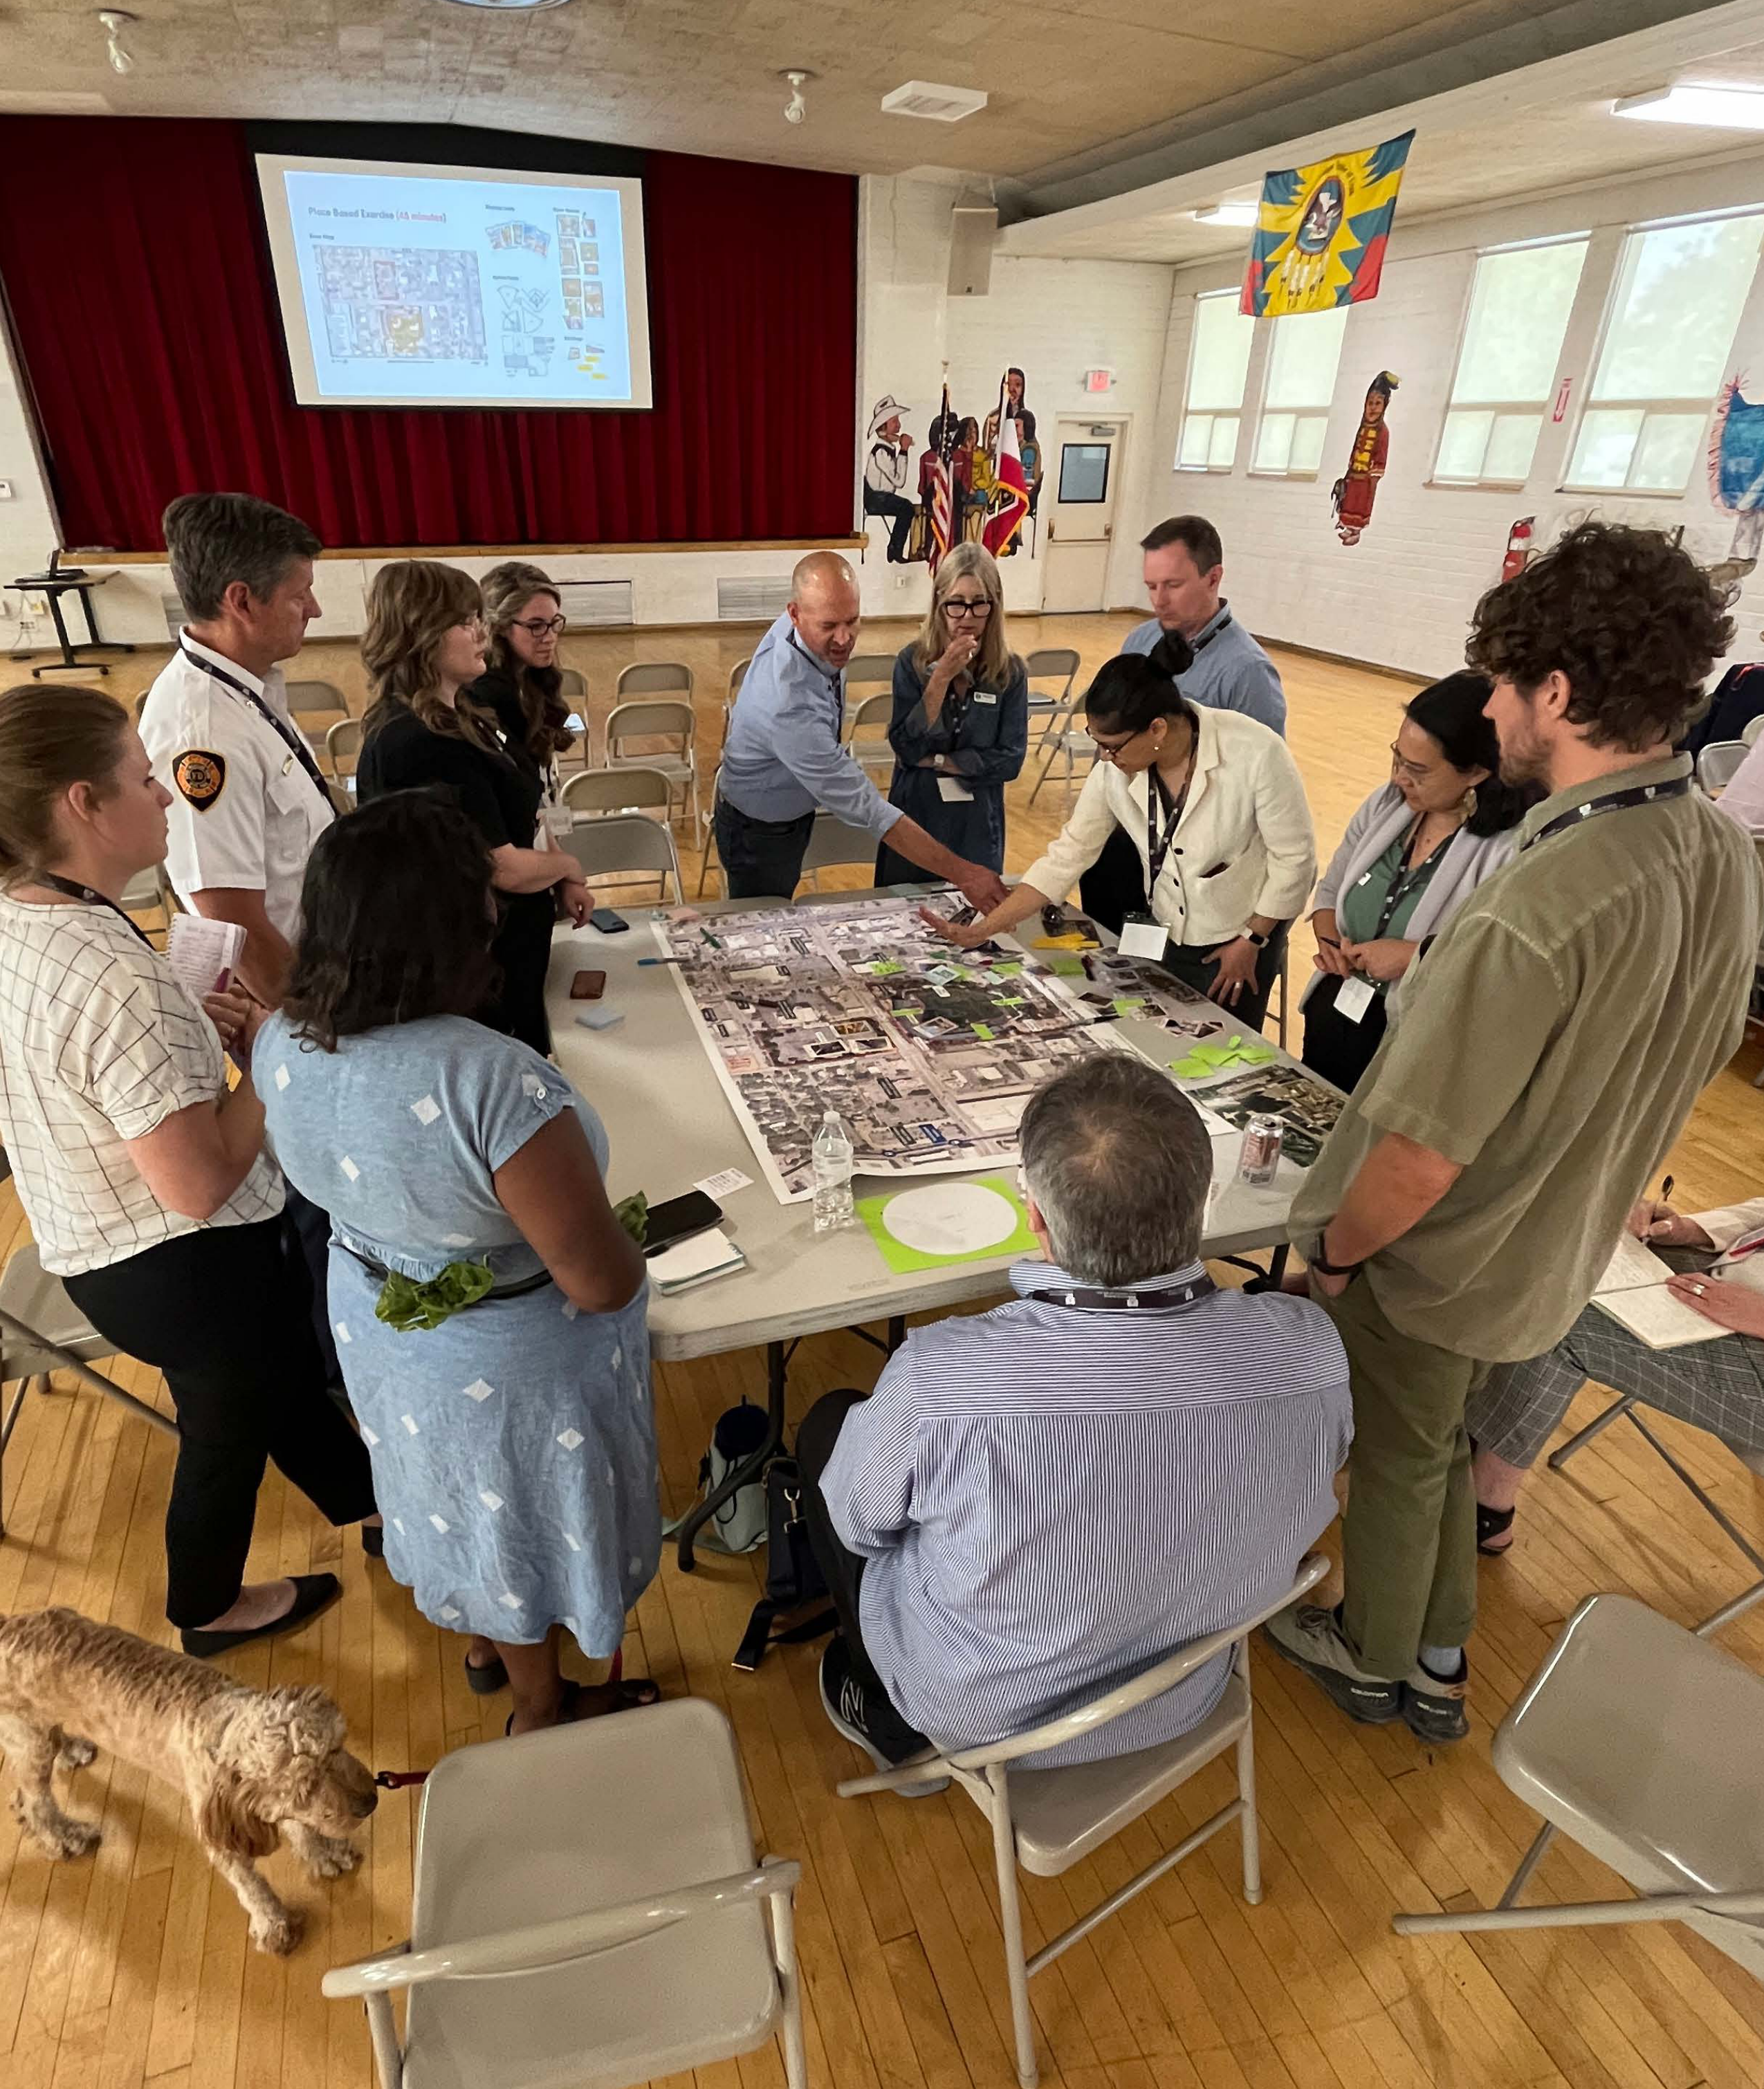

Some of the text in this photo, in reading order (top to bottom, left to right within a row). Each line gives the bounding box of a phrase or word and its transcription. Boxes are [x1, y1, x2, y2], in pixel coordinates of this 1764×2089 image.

[309, 207, 331, 217] Place
[333, 208, 359, 218] Based
[360, 209, 395, 219] Exercise
